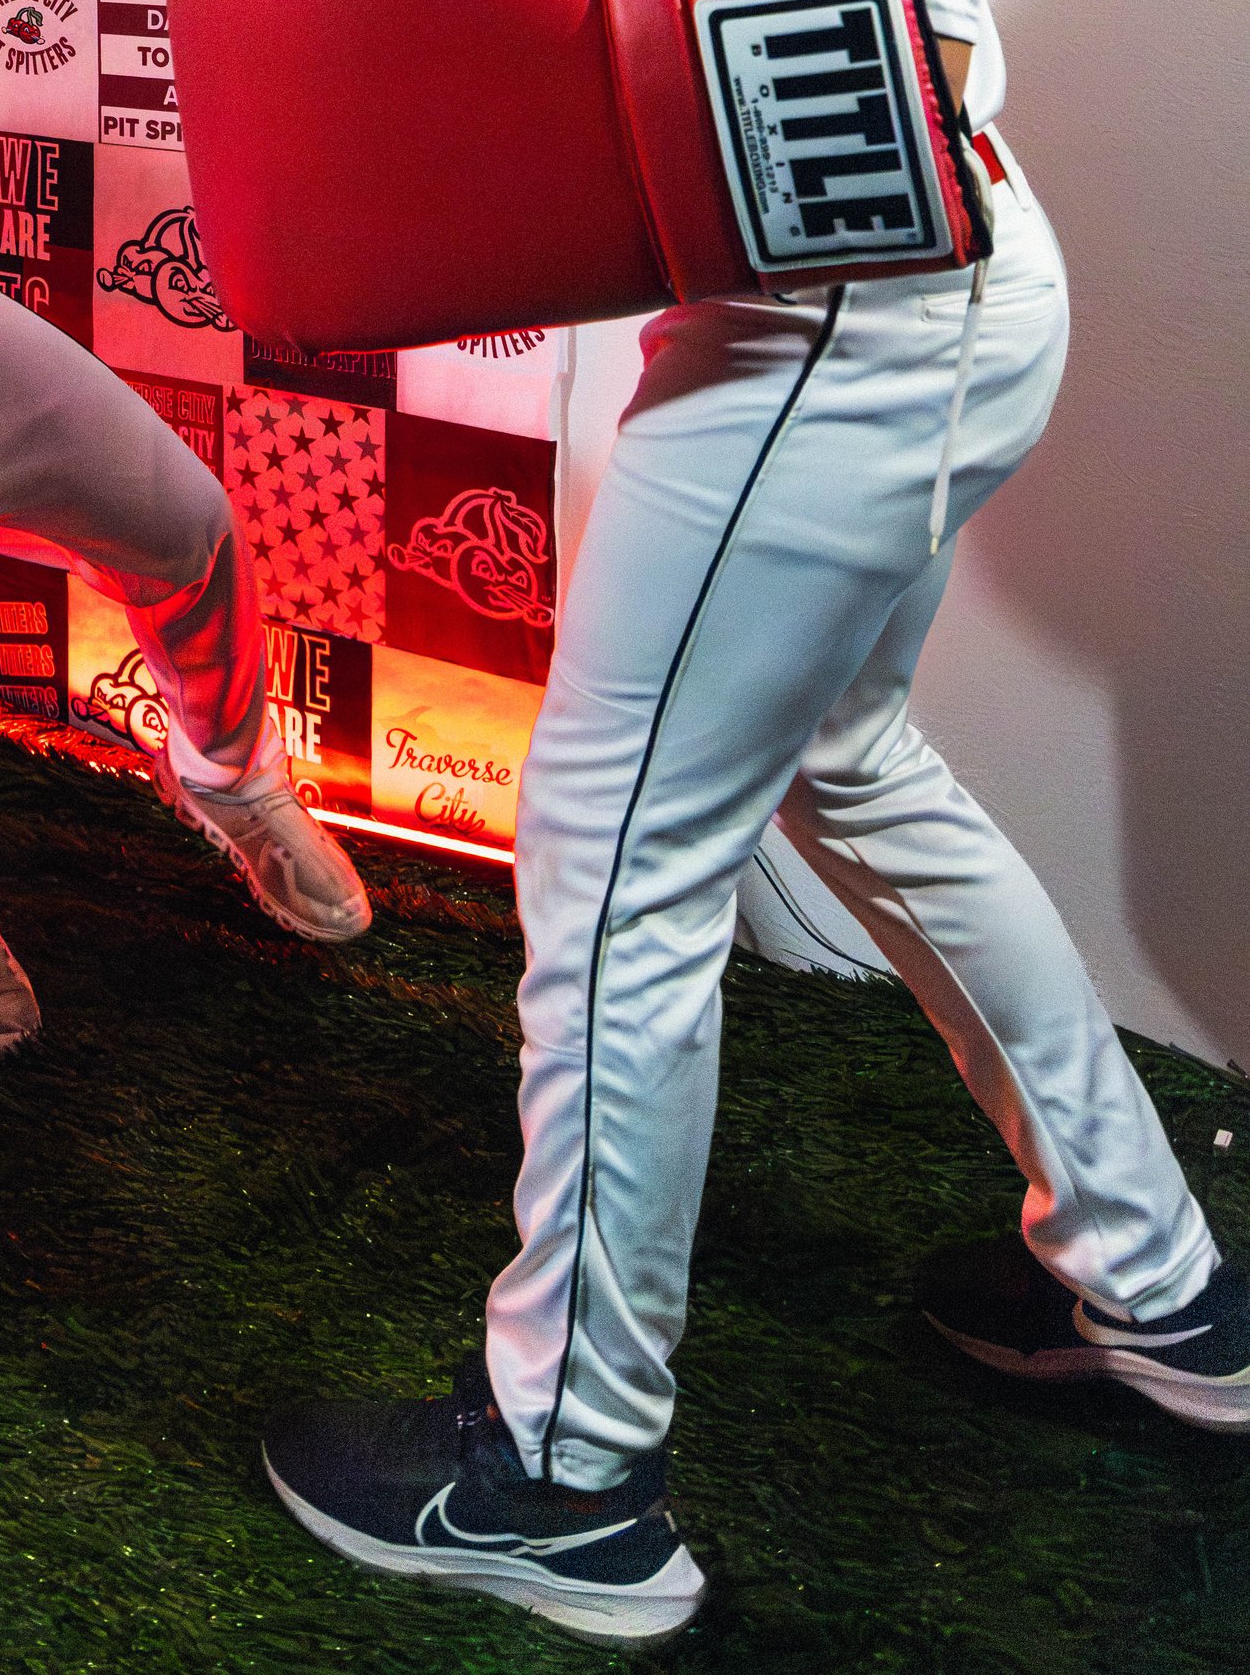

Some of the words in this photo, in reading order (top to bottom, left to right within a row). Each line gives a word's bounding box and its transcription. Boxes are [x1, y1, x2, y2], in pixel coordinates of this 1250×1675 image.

[5, 36, 76, 75] SPITTERS
[137, 46, 170, 68] TO
[103, 116, 139, 140] PIT
[764, 8, 918, 238] TITLE
[0, 210, 50, 261] ARE
[178, 390, 215, 424] CITY
[263, 624, 330, 712] WE
[386, 728, 513, 786] Traverse
[414, 782, 486, 836] City
